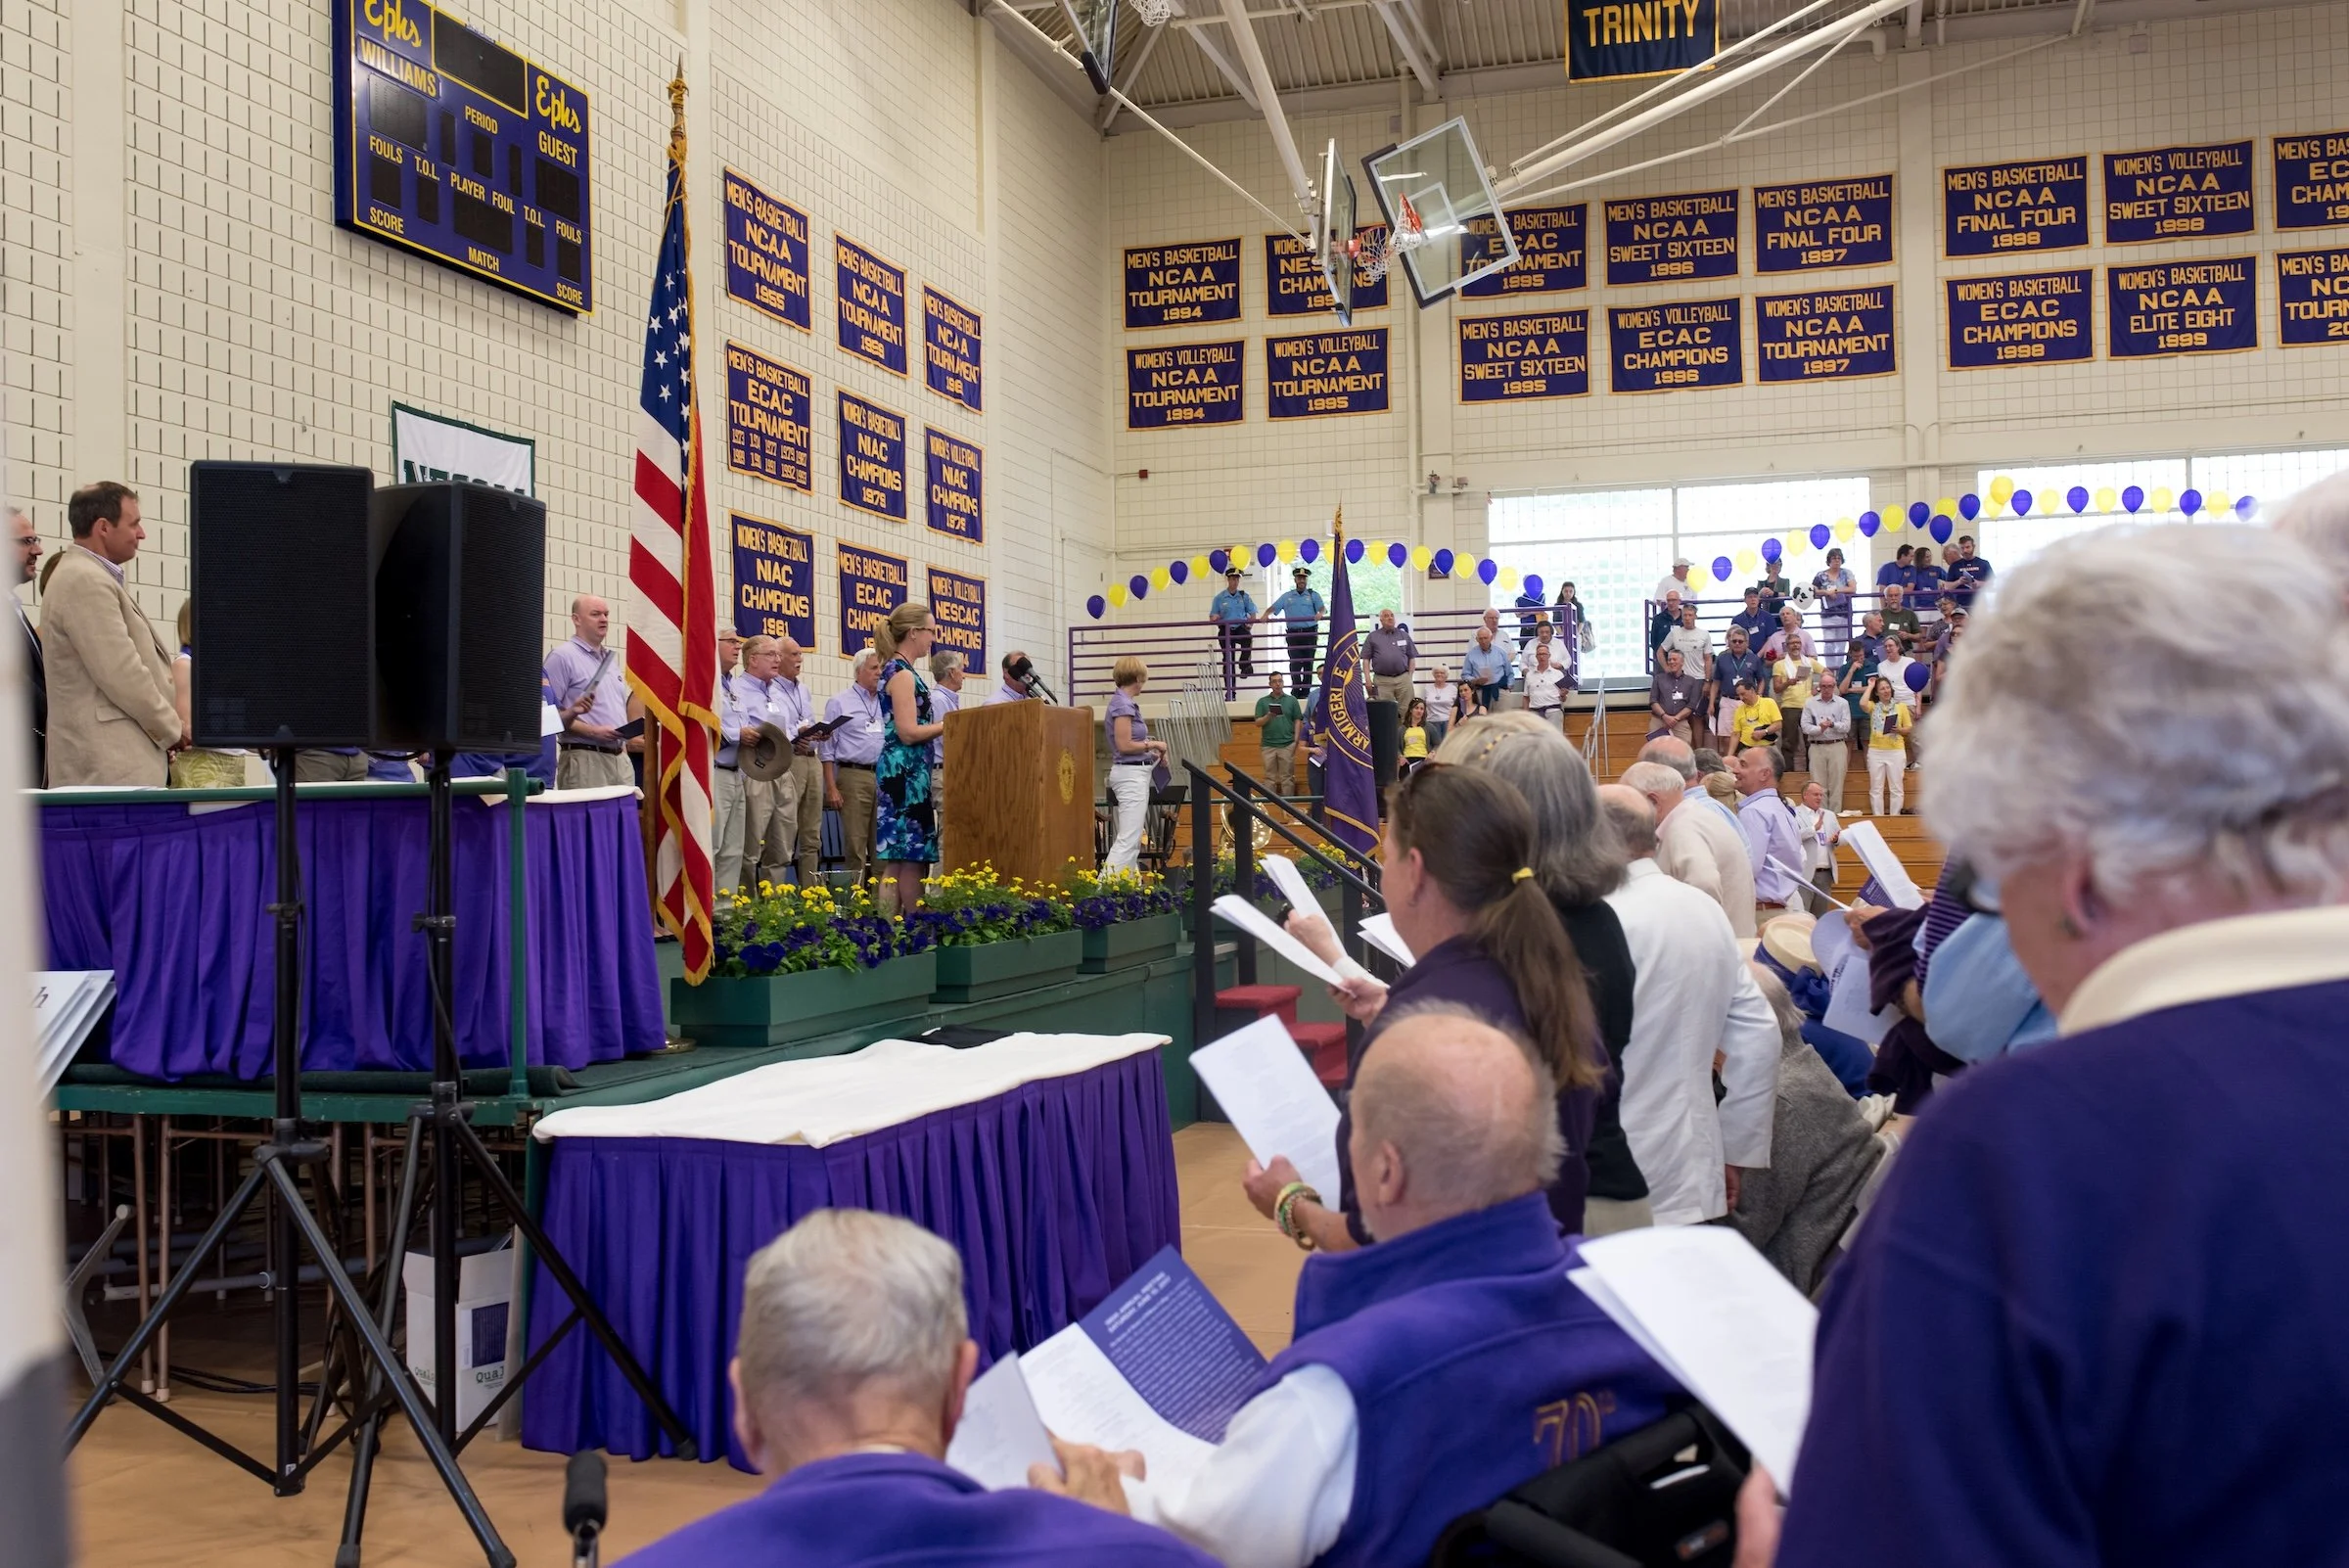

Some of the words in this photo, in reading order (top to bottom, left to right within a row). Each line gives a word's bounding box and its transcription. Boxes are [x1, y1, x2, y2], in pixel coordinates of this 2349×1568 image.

[1583, 0, 1700, 47] TRINITY
[361, 37, 437, 97] WILLIAMS
[535, 74, 581, 135] Ephs
[465, 106, 498, 135] PERIOD
[538, 130, 577, 168] GUEST
[2277, 140, 2322, 160] MEN'S
[2326, 137, 2349, 157] BA
[2114, 155, 2163, 176] WOMEN'S
[2168, 149, 2242, 170] VOLLEYBALL
[369, 135, 403, 164] FOULS
[414, 155, 440, 181] T.O.L.
[450, 171, 485, 202] PLAYER
[492, 190, 516, 215] FOUL
[523, 205, 546, 228] T.O.L.
[556, 219, 582, 245] FOULS
[1948, 171, 1988, 191] MEN'S
[1992, 163, 2083, 188] BASKETBALL
[2136, 173, 2221, 196] NCAA
[1757, 189, 1796, 208] MEN'S
[1801, 181, 1889, 206] BASKETBALL
[1974, 187, 2056, 211] NCAA
[2109, 199, 2168, 220] SWEET
[2174, 192, 2250, 214] SIXTEEN
[369, 207, 404, 234] SCORE
[726, 179, 754, 214] MEN'S
[755, 196, 806, 244] BASKETBALL
[1514, 210, 1578, 231] BASKETBALL
[1607, 202, 1646, 222] MEN'S
[1650, 196, 1735, 219] BASKETBALL
[1784, 205, 1863, 228] NCAA
[1958, 212, 2014, 233] FINAL
[2020, 207, 2076, 228] FOUR
[1634, 218, 1710, 241] NCAA
[1766, 229, 1822, 251] FINAL
[1827, 224, 1882, 247] FOUR
[2155, 217, 2204, 235] 1998
[746, 218, 792, 263] NCAA
[1610, 243, 1662, 263] SWEET
[1668, 237, 1735, 259] SIXTEEN
[1992, 231, 2041, 248] 1998
[468, 247, 500, 272] MATCH
[728, 240, 806, 298] TOURNAMENT
[1127, 250, 1160, 269] MEN'S
[1165, 244, 1237, 266] BASKETBALL
[1466, 250, 1583, 275] TONAMENT
[1800, 248, 1848, 264] 1997
[2281, 255, 2325, 275] MEN'S
[837, 243, 859, 274] MEN'S
[860, 255, 902, 298] BASKETBALL
[1148, 265, 1216, 287] NCAA
[1502, 274, 1545, 290] 1995
[1649, 262, 1694, 278] 1996
[2118, 270, 2165, 291] WOMEN'S
[2171, 264, 2246, 287] BASKETBALL
[556, 282, 583, 305] SCORE
[852, 278, 891, 317] NCAA
[1128, 282, 1236, 307] TOURNAMENT
[1957, 281, 2004, 301] WOMEN'S
[2008, 275, 2082, 298] BASKETBALL
[2139, 287, 2225, 311] NCAA
[1163, 305, 1203, 321] 1994
[1617, 309, 1661, 330] WOMEN'S
[1665, 304, 1731, 326] VOLLEYBALL
[1765, 298, 1811, 317] WOMEN'S
[1815, 292, 1884, 314] BASKETBALL
[1980, 300, 2060, 322] ECAC
[840, 297, 902, 346] TOURNAMENT
[1462, 320, 1499, 341] MEN'S
[1503, 314, 1586, 337] BASKETBALL
[1785, 318, 1865, 338] NCAA
[1963, 319, 2078, 345] CHAMPIONS
[2130, 312, 2180, 334] ELITE
[2185, 308, 2235, 330] EIGHT
[937, 324, 969, 358] NCAA
[1274, 339, 1314, 358] WOMEN'S
[1318, 334, 1379, 354] VOLLEYBALL
[1487, 338, 1561, 359] NCAA
[1638, 327, 1712, 349] ECAC
[1763, 334, 1889, 360] TOURNAMENT
[2158, 333, 2208, 349] 1999
[926, 342, 980, 384] TOURNAMENT
[1134, 350, 1173, 369] WOMEN'S
[1175, 346, 1236, 366] VOLLEYBALL
[1623, 346, 1728, 370] CHAMPIONS
[1997, 344, 2046, 360] 1998
[727, 348, 755, 375] MEN'S
[757, 360, 808, 398] BASKETBALL
[1151, 367, 1219, 388] NCAA
[1292, 355, 1361, 376] NCAA
[1464, 360, 1516, 381] SWEET
[1520, 355, 1586, 377] SIXTEEN
[1654, 369, 1700, 385] 1996
[1803, 358, 1850, 375] 1997
[748, 378, 793, 416] ECAC
[1132, 384, 1239, 408] TOURNAMENT
[1272, 372, 1384, 397] TOURNAMENT
[1502, 380, 1546, 395] 1995
[1166, 406, 1205, 422] 1994
[1308, 395, 1349, 411] 1995
[730, 399, 809, 449] TOURNAMENT
[857, 432, 888, 463] NIAC
[847, 454, 901, 492] CHAMPIONS
[943, 464, 968, 490] NIAC
[932, 484, 979, 518] CHAMPIONS
[737, 524, 765, 553] WOMEN'S
[767, 530, 808, 563] BASKETBALL
[757, 558, 793, 587] NIAC
[840, 551, 862, 576] MEN'S
[863, 556, 907, 586] BASKETBALL
[742, 583, 809, 619] CHAMPIONS
[855, 581, 893, 610] ECAC
[935, 600, 980, 626] NESCAC
[762, 617, 790, 637] 1981
[935, 624, 982, 650] CHAMPIONS
[1332, 667, 1348, 679] E
[1330, 687, 1370, 751] ARMIGERI
